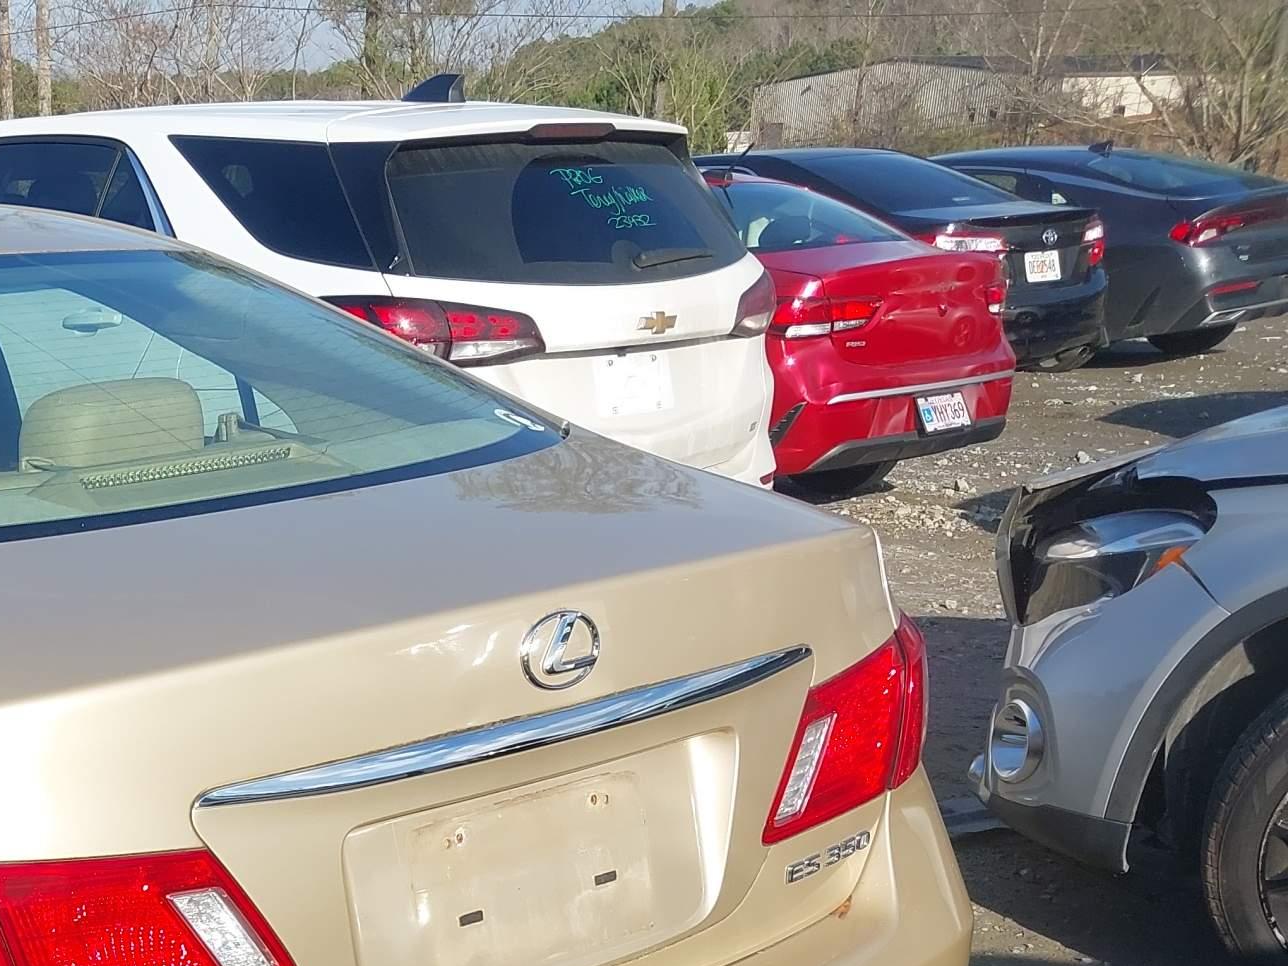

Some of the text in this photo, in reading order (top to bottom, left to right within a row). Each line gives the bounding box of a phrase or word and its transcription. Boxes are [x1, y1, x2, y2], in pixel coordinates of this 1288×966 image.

[931, 401, 965, 423] YHY369
[786, 830, 871, 884] ES 350
